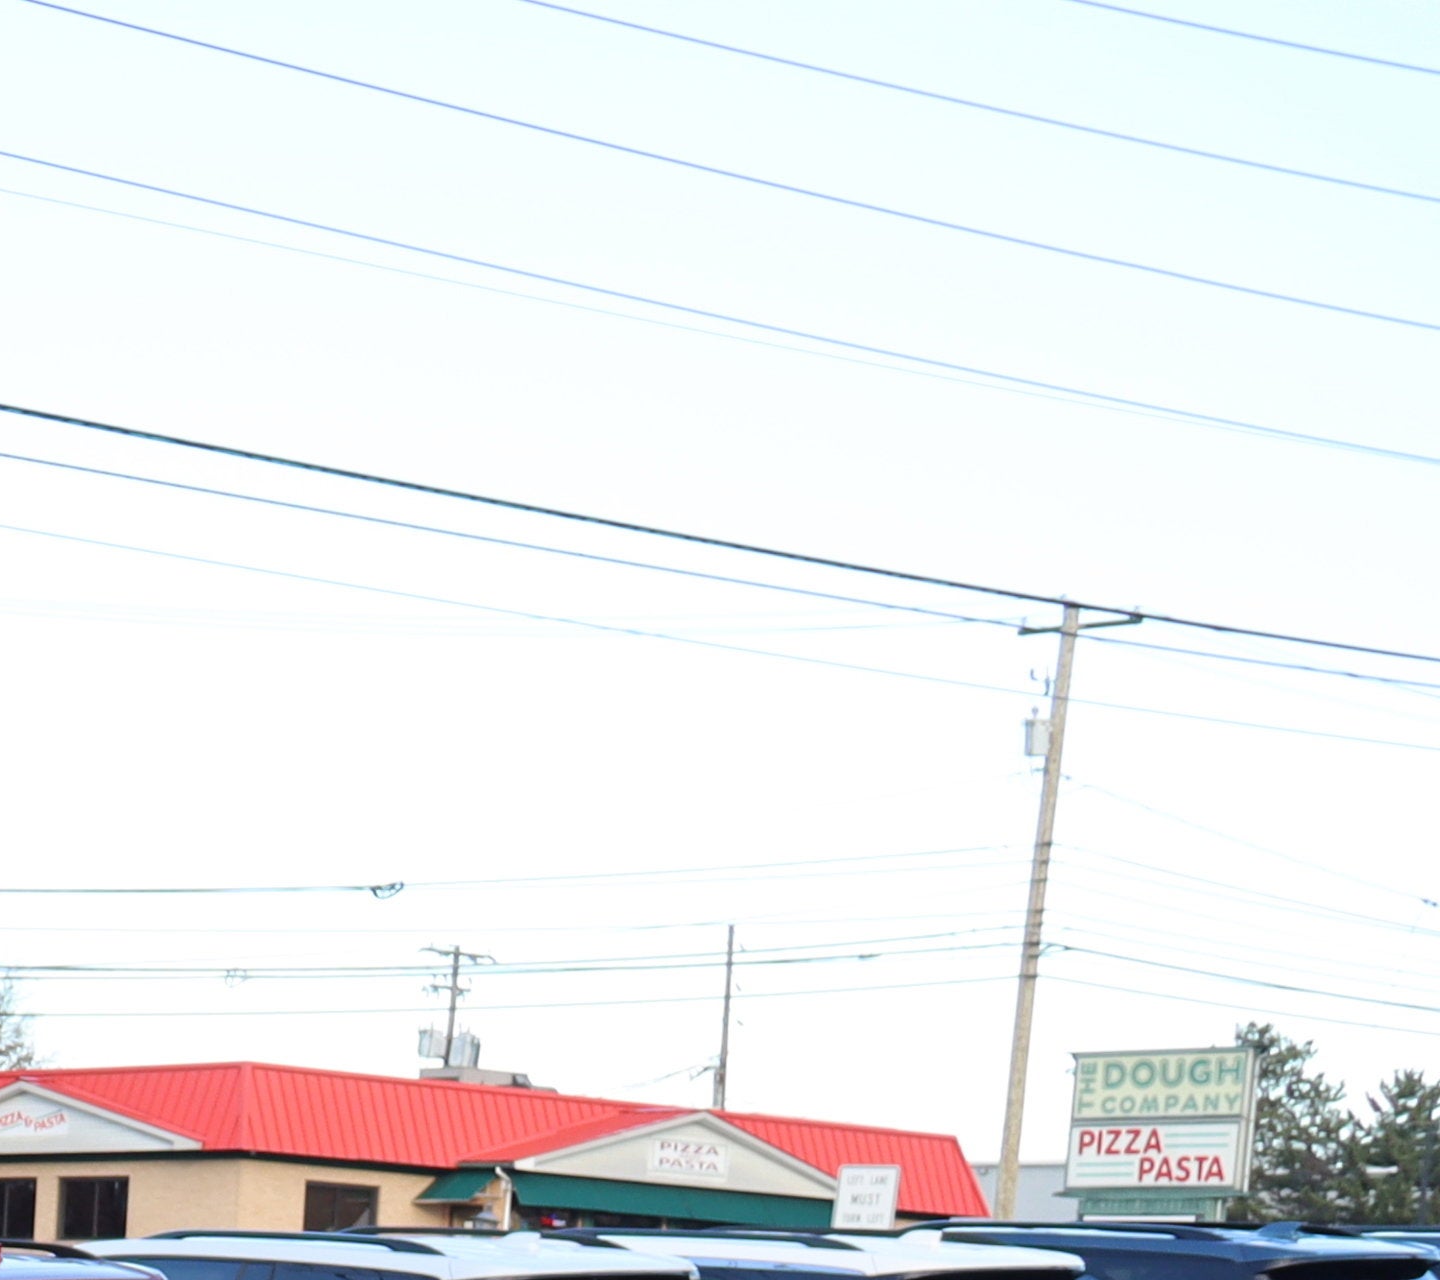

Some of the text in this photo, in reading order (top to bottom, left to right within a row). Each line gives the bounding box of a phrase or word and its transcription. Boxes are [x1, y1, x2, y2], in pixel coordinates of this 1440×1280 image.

[1102, 1056, 1244, 1090] DOUGH
[1077, 1061, 1098, 1114] THE
[1100, 1093, 1241, 1114] COMPANY
[34, 1112, 66, 1132] PASTA
[659, 1140, 719, 1157] PIZZA
[1078, 1128, 1163, 1155] PIZZA
[658, 1157, 719, 1172] PASTA
[1137, 1156, 1225, 1182] PASTA
[850, 1192, 882, 1206] MUST
